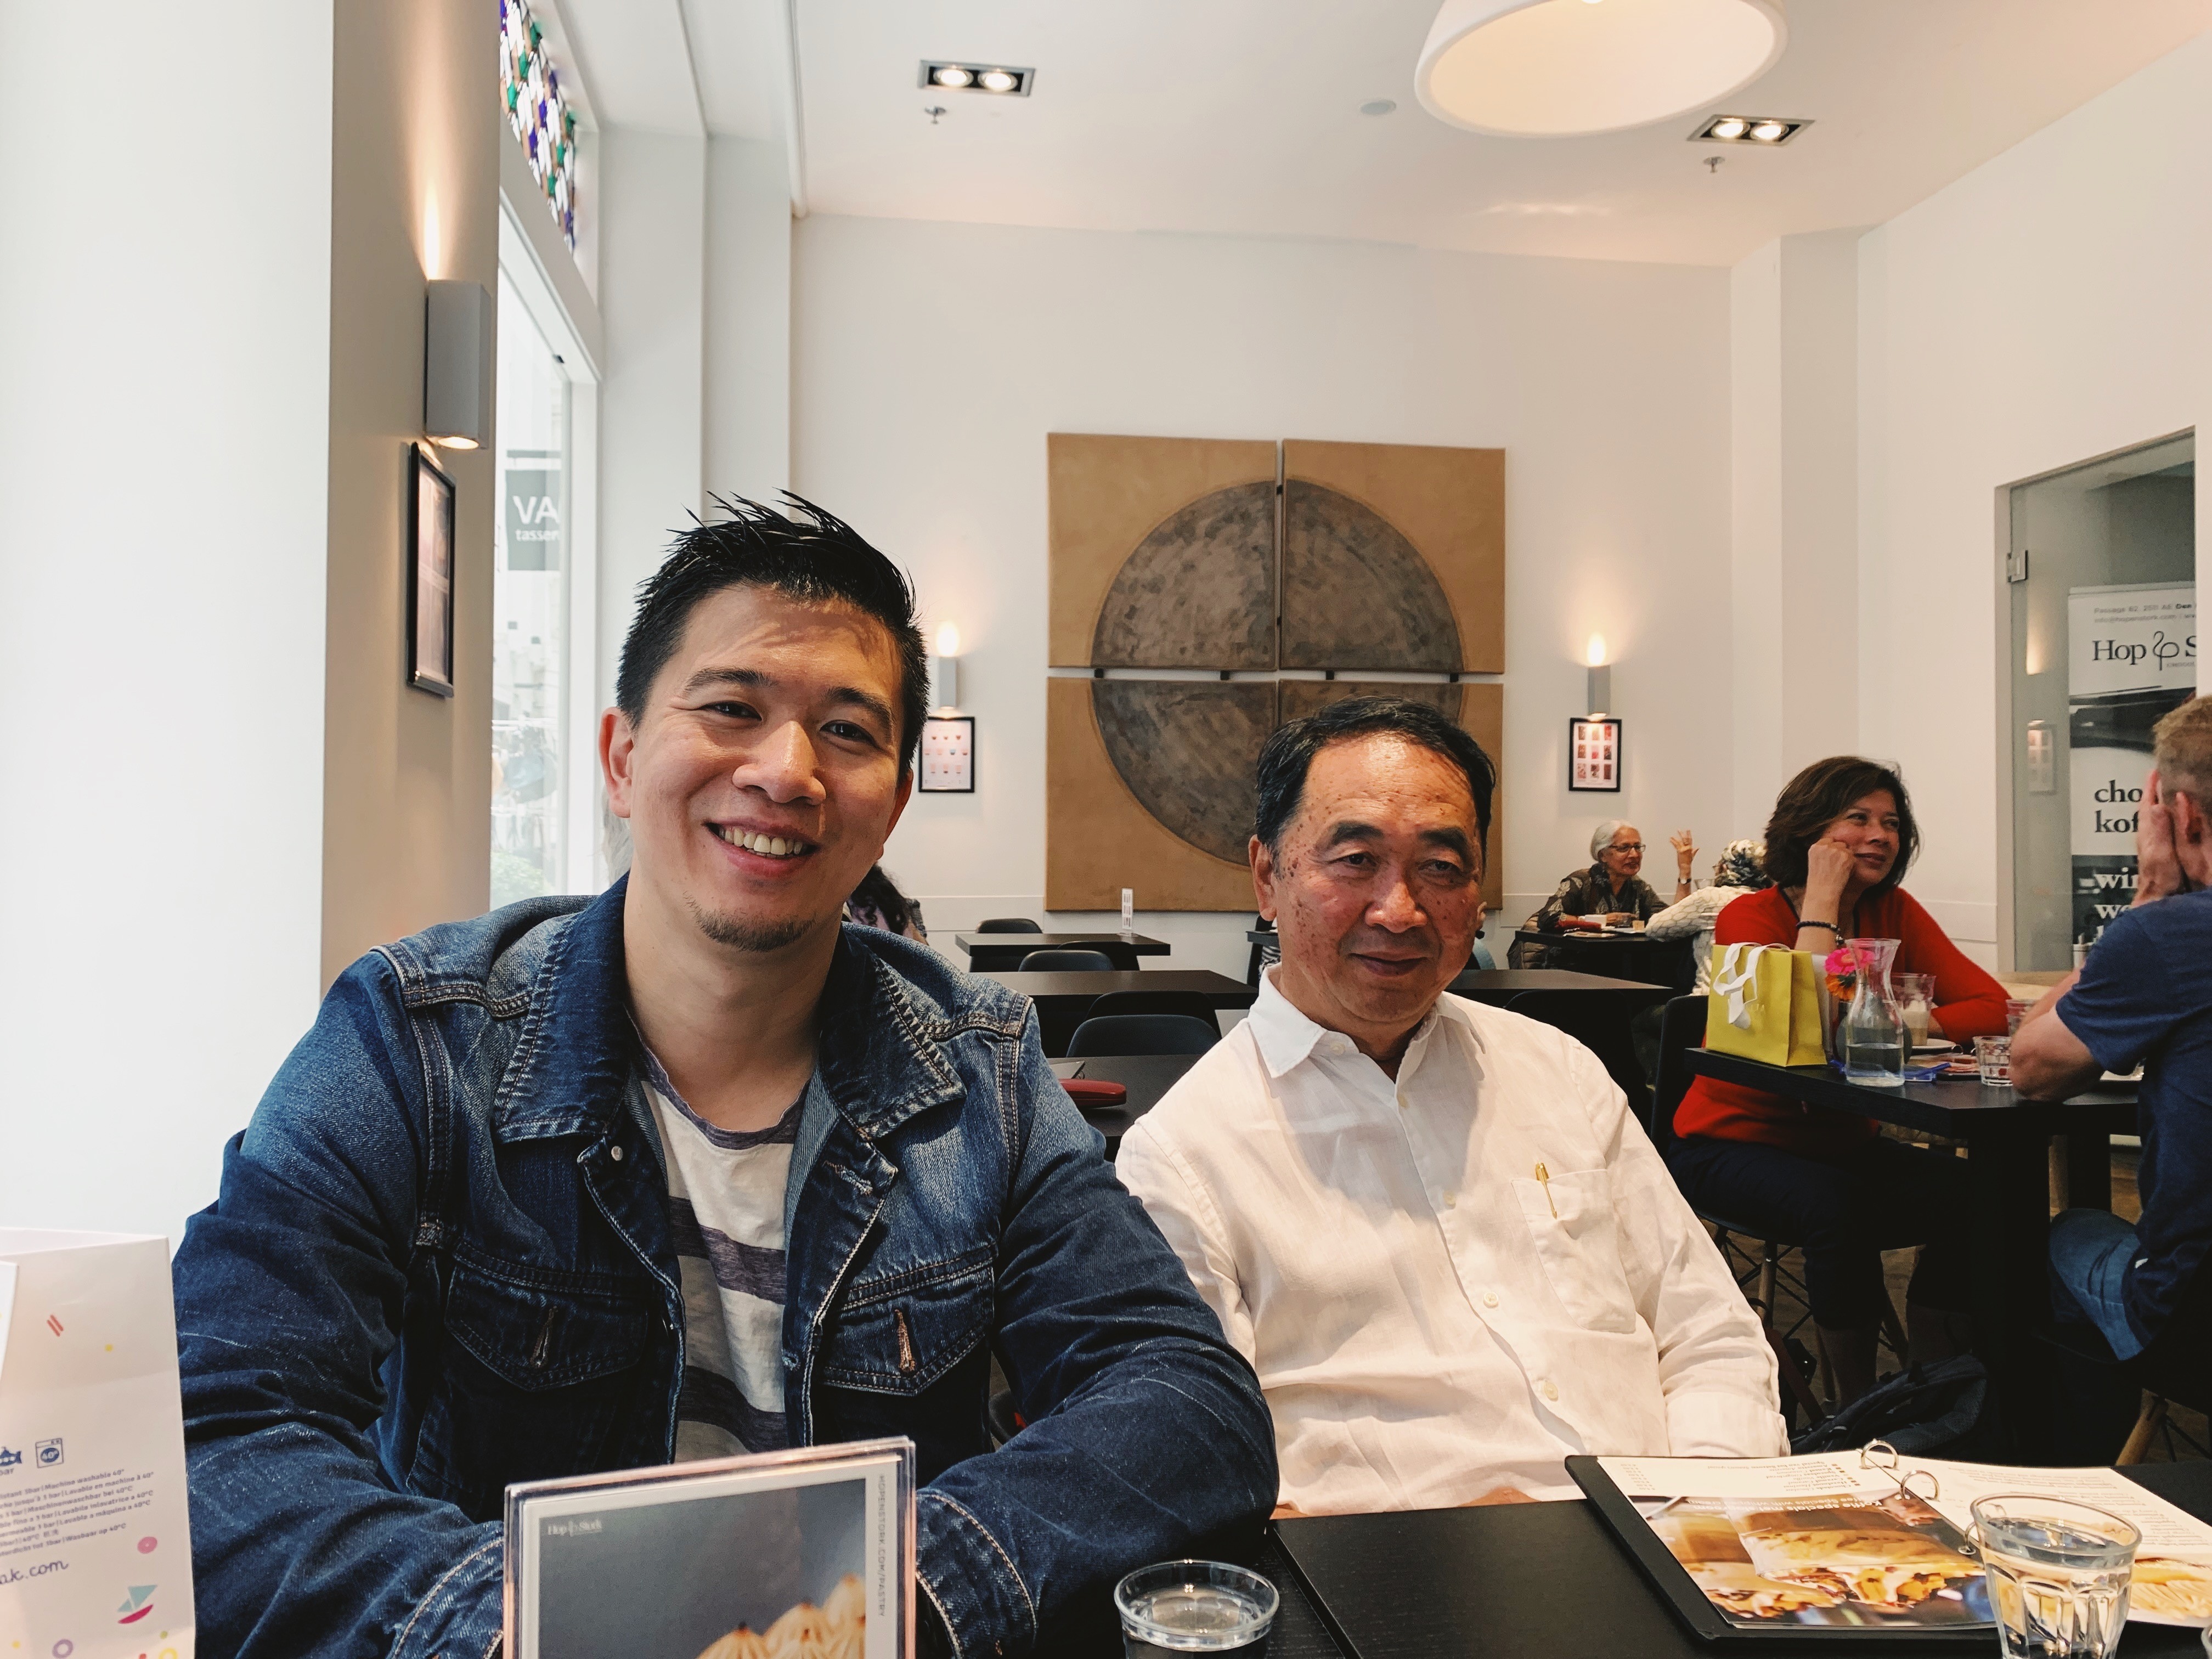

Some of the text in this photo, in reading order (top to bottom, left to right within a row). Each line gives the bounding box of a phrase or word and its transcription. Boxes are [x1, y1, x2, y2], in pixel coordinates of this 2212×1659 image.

[513, 495, 560, 524] VA
[2092, 640, 2146, 665] Hop
[1787, 1503, 1840, 1512] specials
[1843, 1500, 1882, 1509] Koffie
